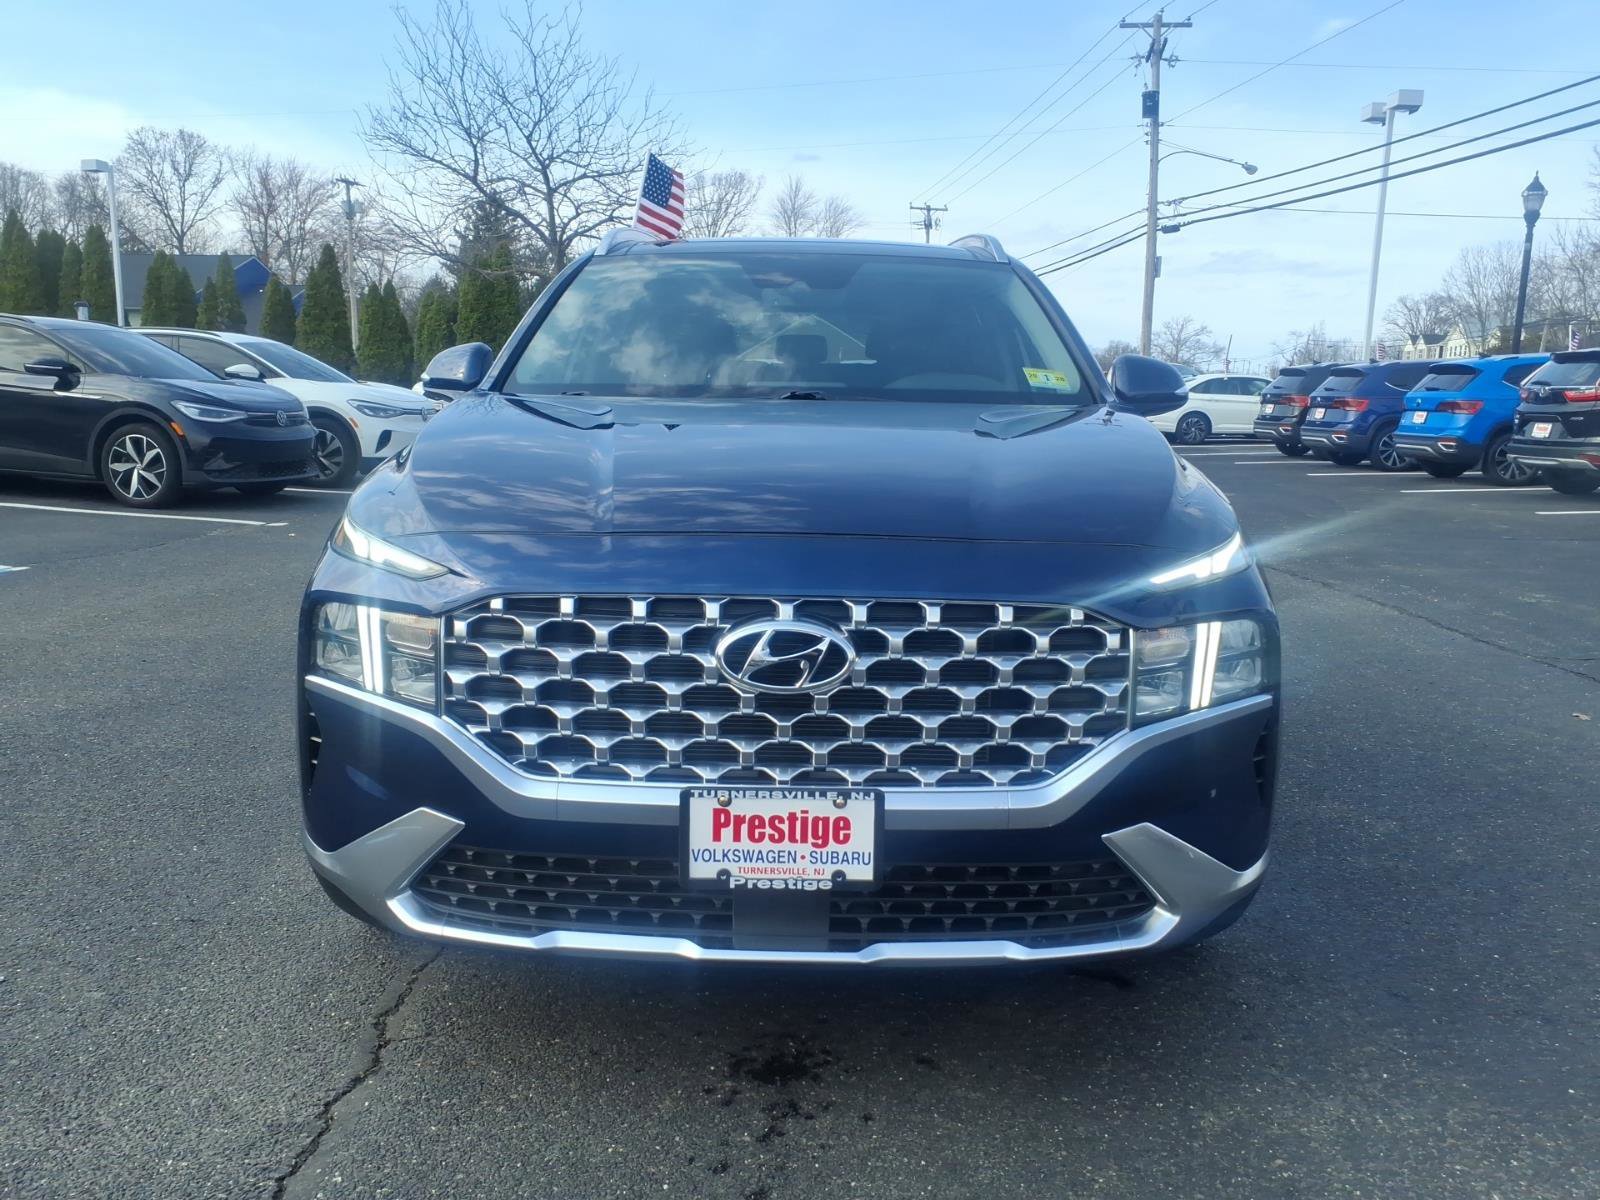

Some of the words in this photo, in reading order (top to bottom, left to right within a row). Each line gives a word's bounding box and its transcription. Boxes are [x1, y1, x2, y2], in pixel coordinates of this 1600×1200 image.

[850, 791, 875, 800] NJ
[712, 807, 852, 849] Prestige
[691, 848, 797, 864] VOLKSWAGEN
[809, 850, 872, 865] SUBARU
[737, 866, 810, 876] TURNERSVILLE,
[813, 868, 825, 876] NJ
[729, 876, 833, 891] Prestige
